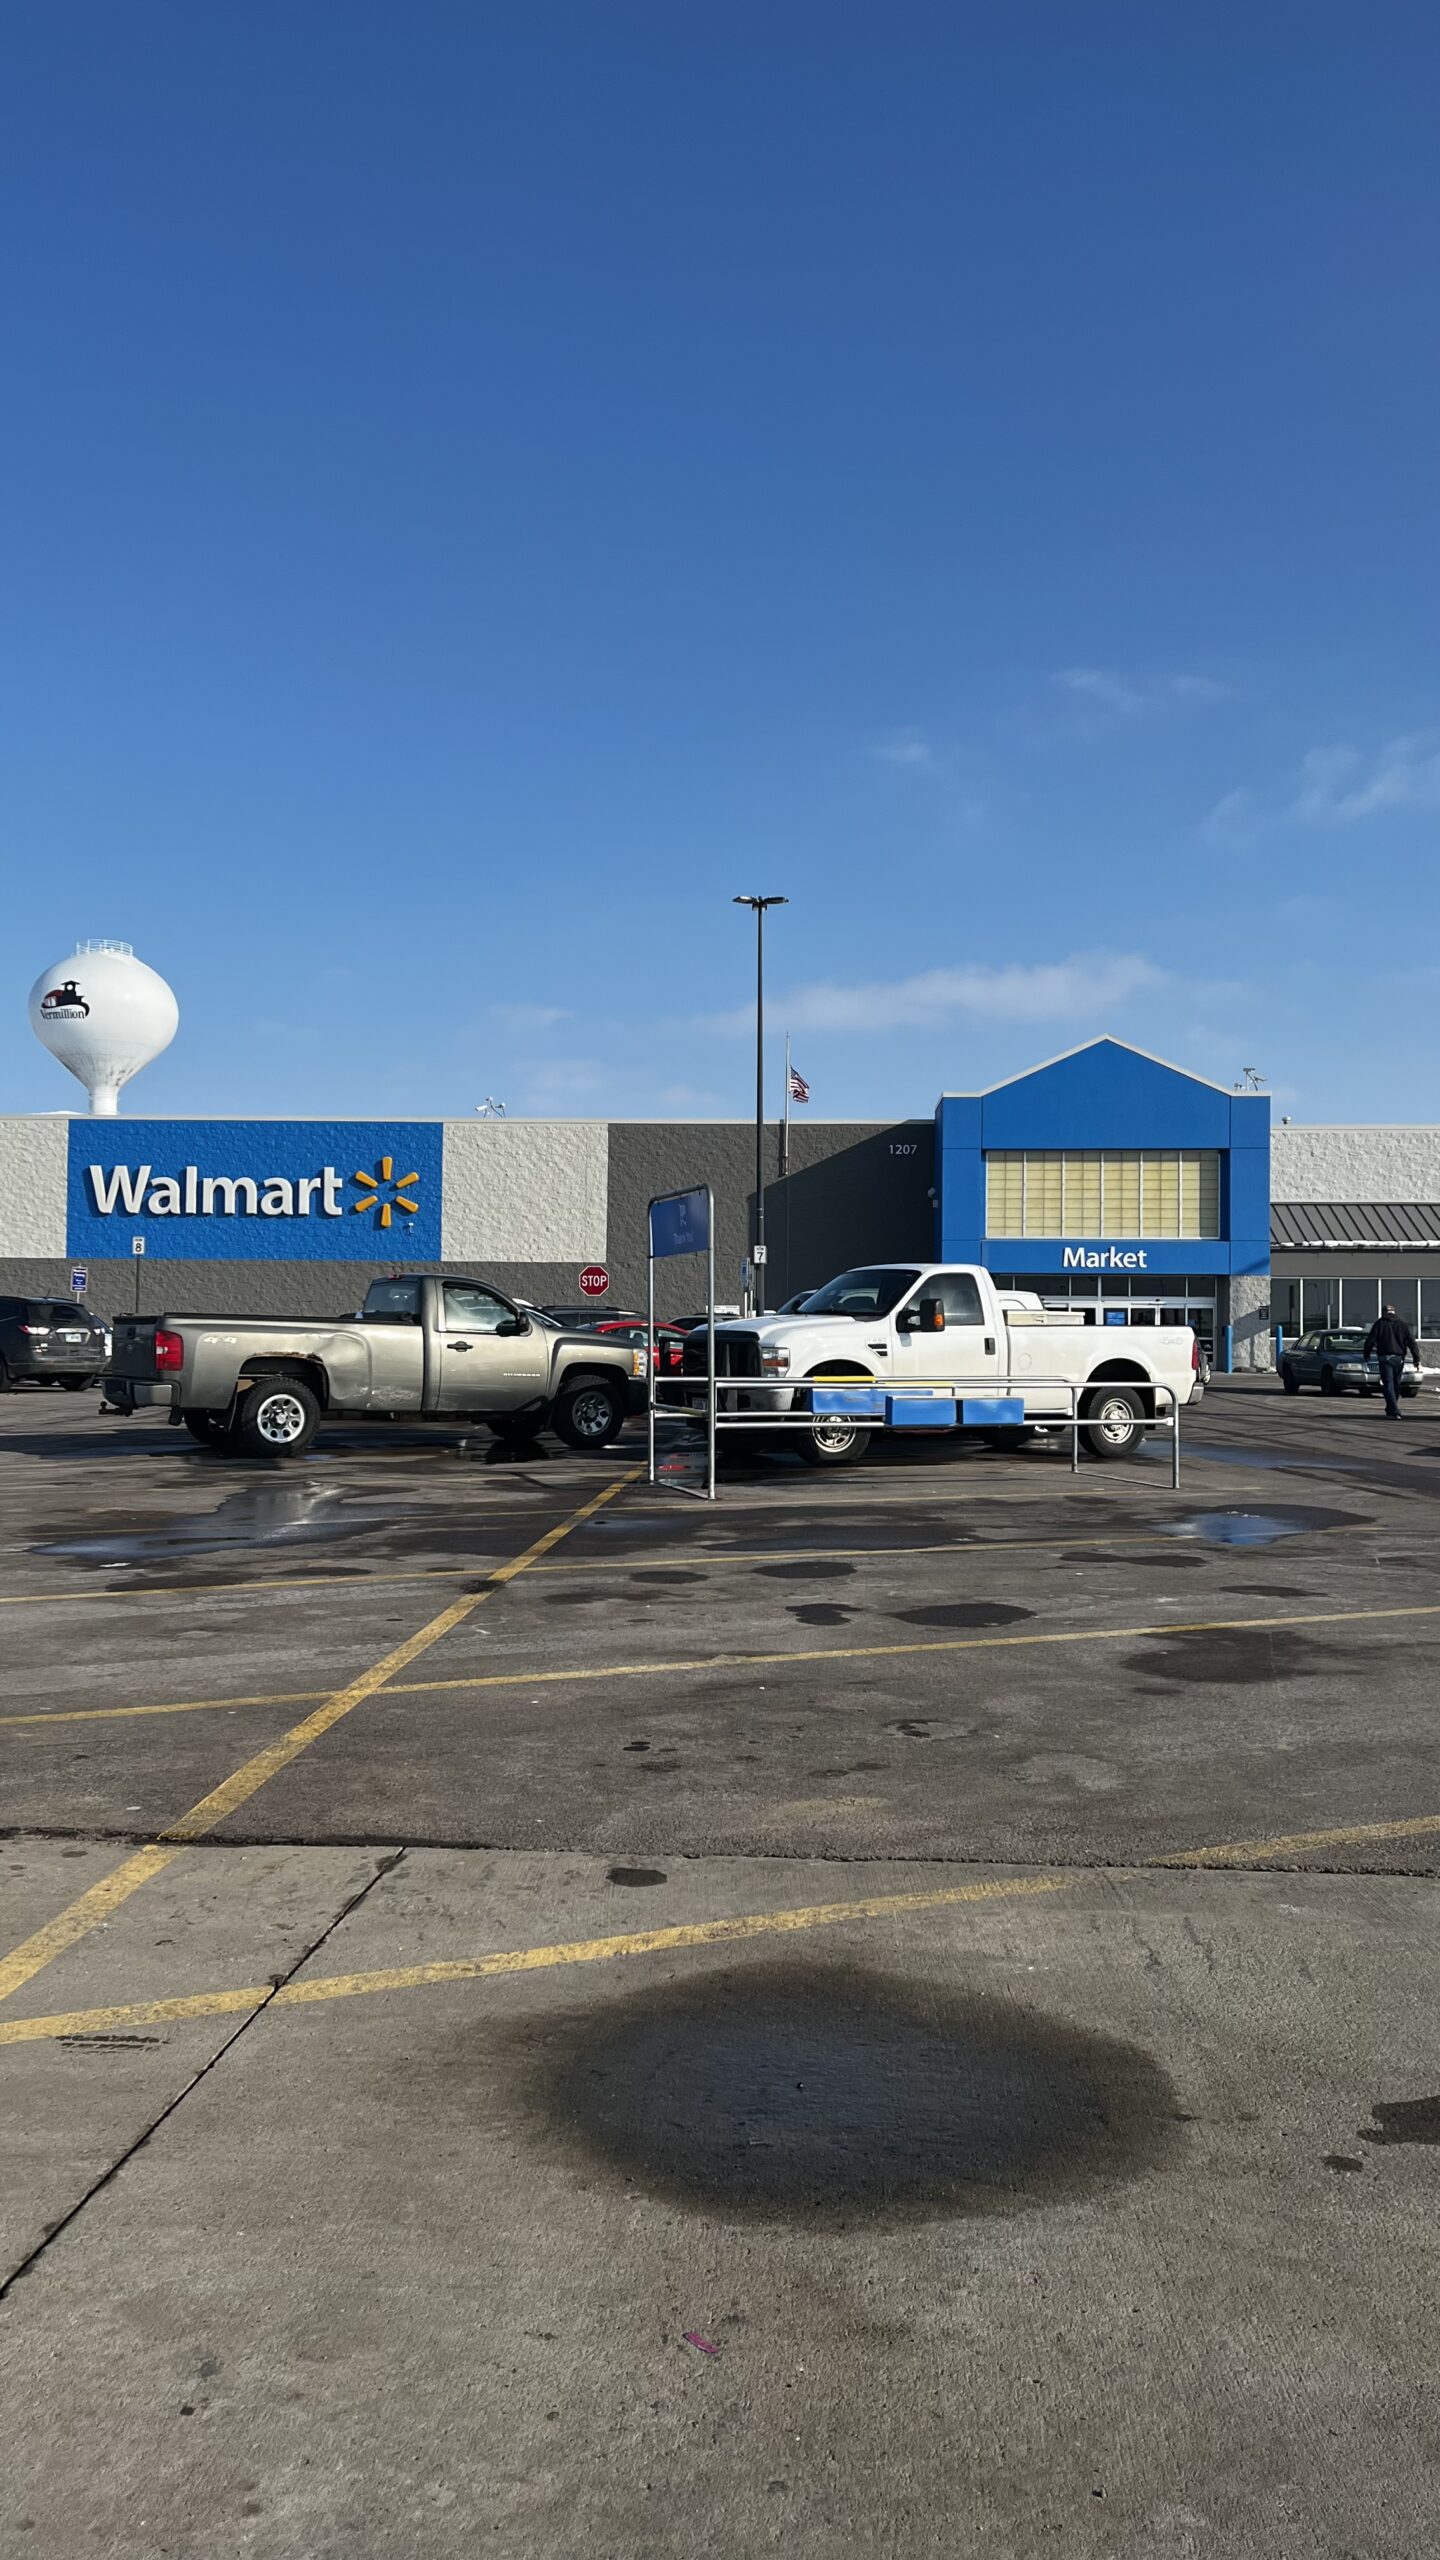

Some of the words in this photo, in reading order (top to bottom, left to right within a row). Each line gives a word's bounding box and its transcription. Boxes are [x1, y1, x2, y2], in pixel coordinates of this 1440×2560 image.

[40, 1008, 85, 1020] Vermillion
[889, 1144, 918, 1155] 1207
[89, 1165, 343, 1216] Walmart
[135, 1242, 142, 1252] 8
[756, 1251, 764, 1261] 7
[1063, 1246, 1148, 1268] Market
[581, 1275, 607, 1287] STOP
